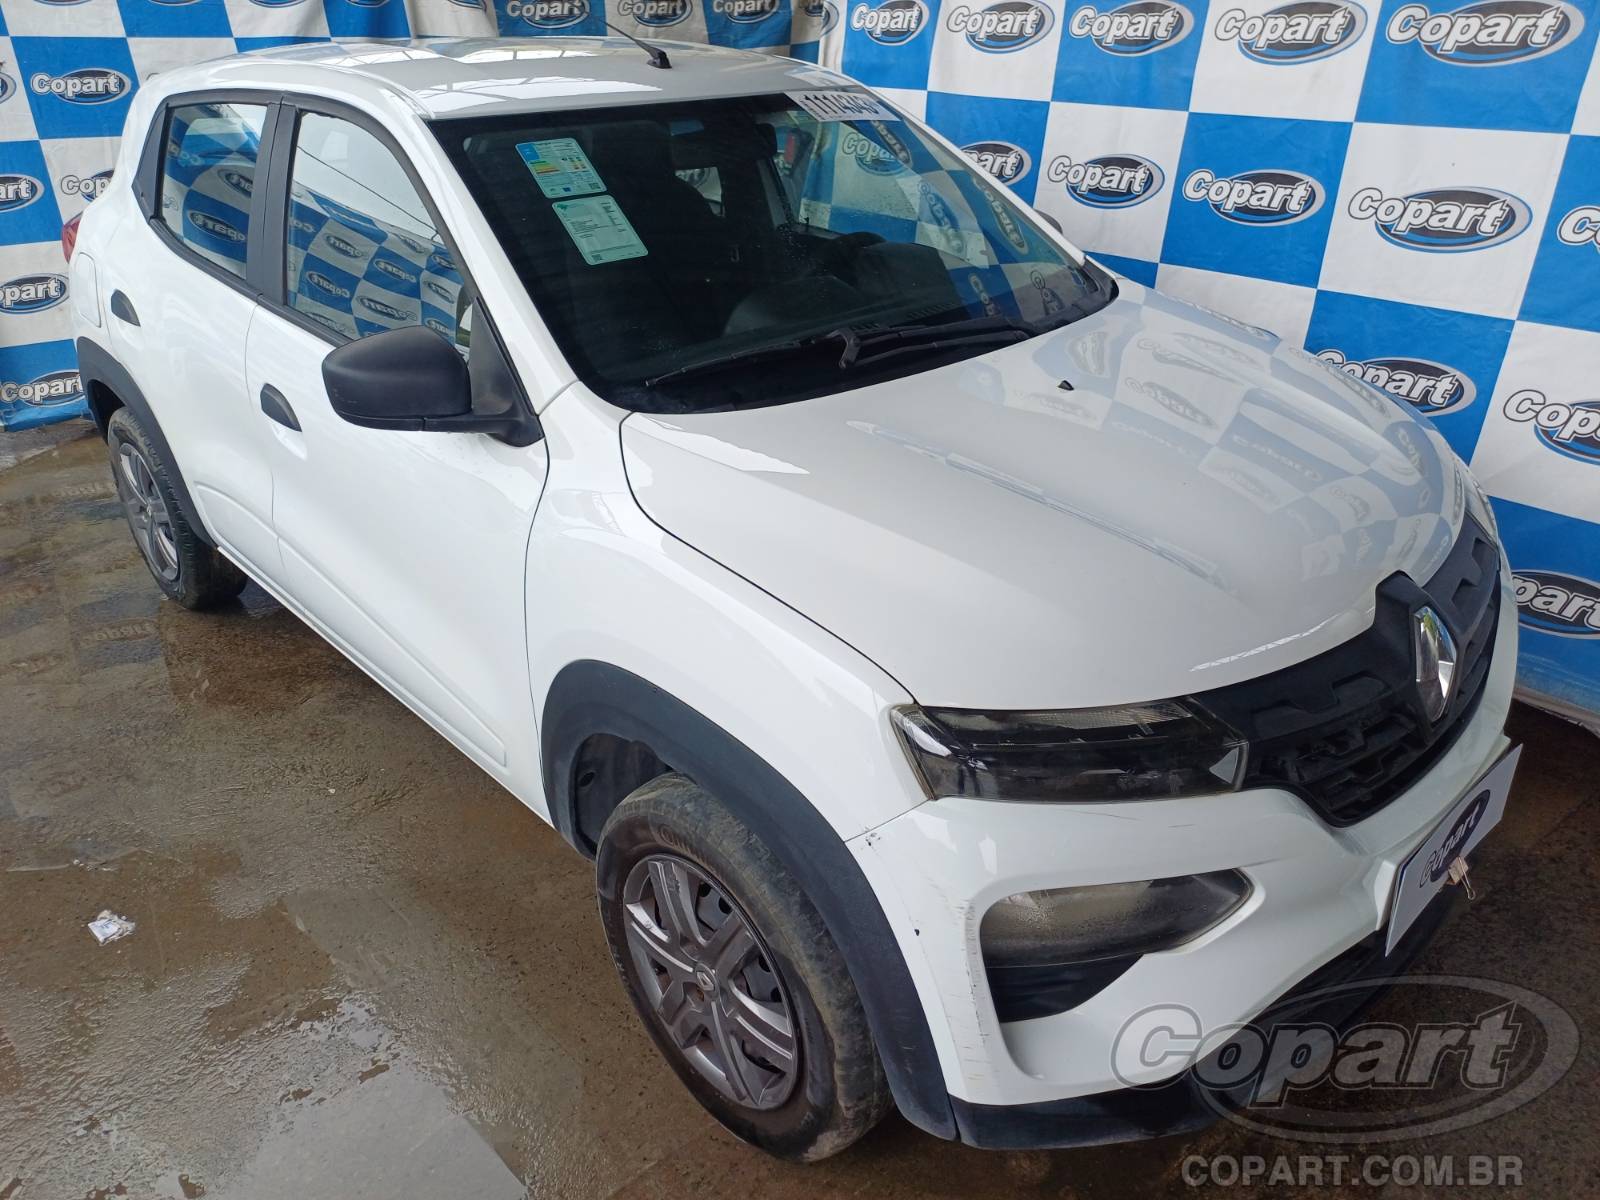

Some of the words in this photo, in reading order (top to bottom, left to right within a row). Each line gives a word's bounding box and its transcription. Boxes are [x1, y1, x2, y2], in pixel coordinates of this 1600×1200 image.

[507, 0, 582, 21] Copart
[617, 0, 683, 19] Copart
[851, 2, 921, 37] Copart
[947, 4, 1041, 42] Copart
[1070, 4, 1181, 46] Copart
[1215, 3, 1350, 50] Copart
[1387, 4, 1564, 54] Copart
[31, 73, 119, 99] Copart
[963, 150, 1021, 177] art
[1048, 155, 1149, 195] Copart
[0, 177, 32, 200] art
[61, 174, 111, 198] Cop
[1183, 169, 1312, 213] Copart
[1348, 187, 1512, 236] Copart
[0, 277, 60, 308] part
[1503, 389, 1600, 441] Cop
[1512, 574, 1600, 630] par
[1419, 801, 1481, 889] Copart
